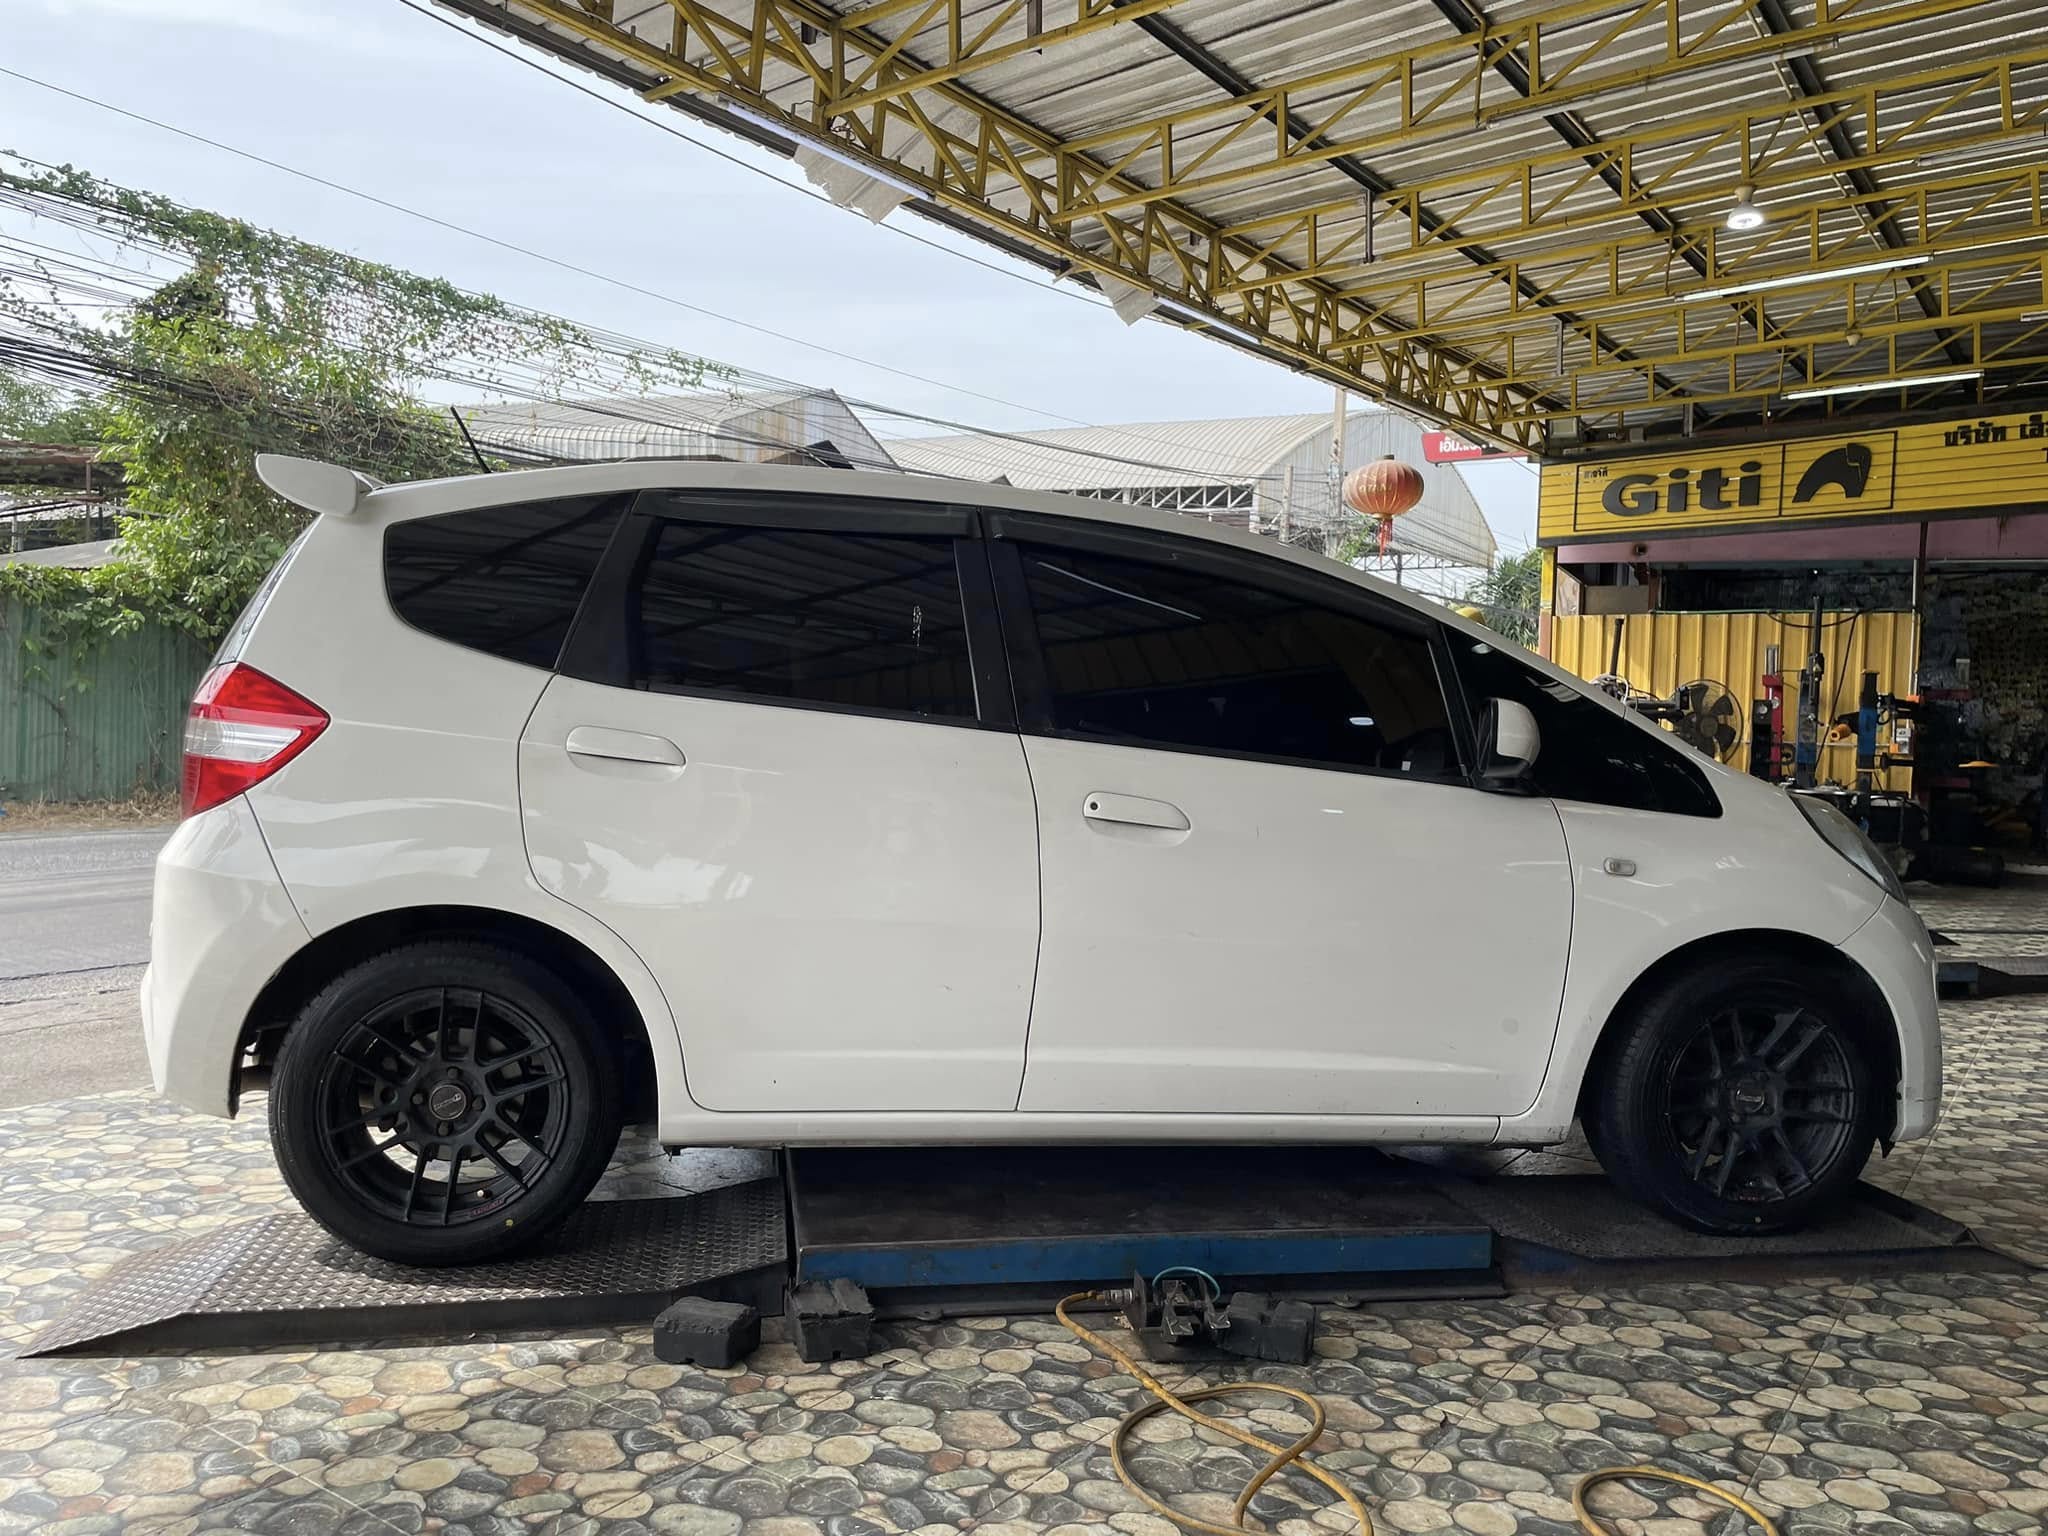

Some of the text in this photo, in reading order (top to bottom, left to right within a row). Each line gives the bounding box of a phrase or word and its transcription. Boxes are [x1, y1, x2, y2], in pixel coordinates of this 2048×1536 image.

[1943, 421, 2007, 447] บริษัท
[1602, 461, 1763, 517] Giti
